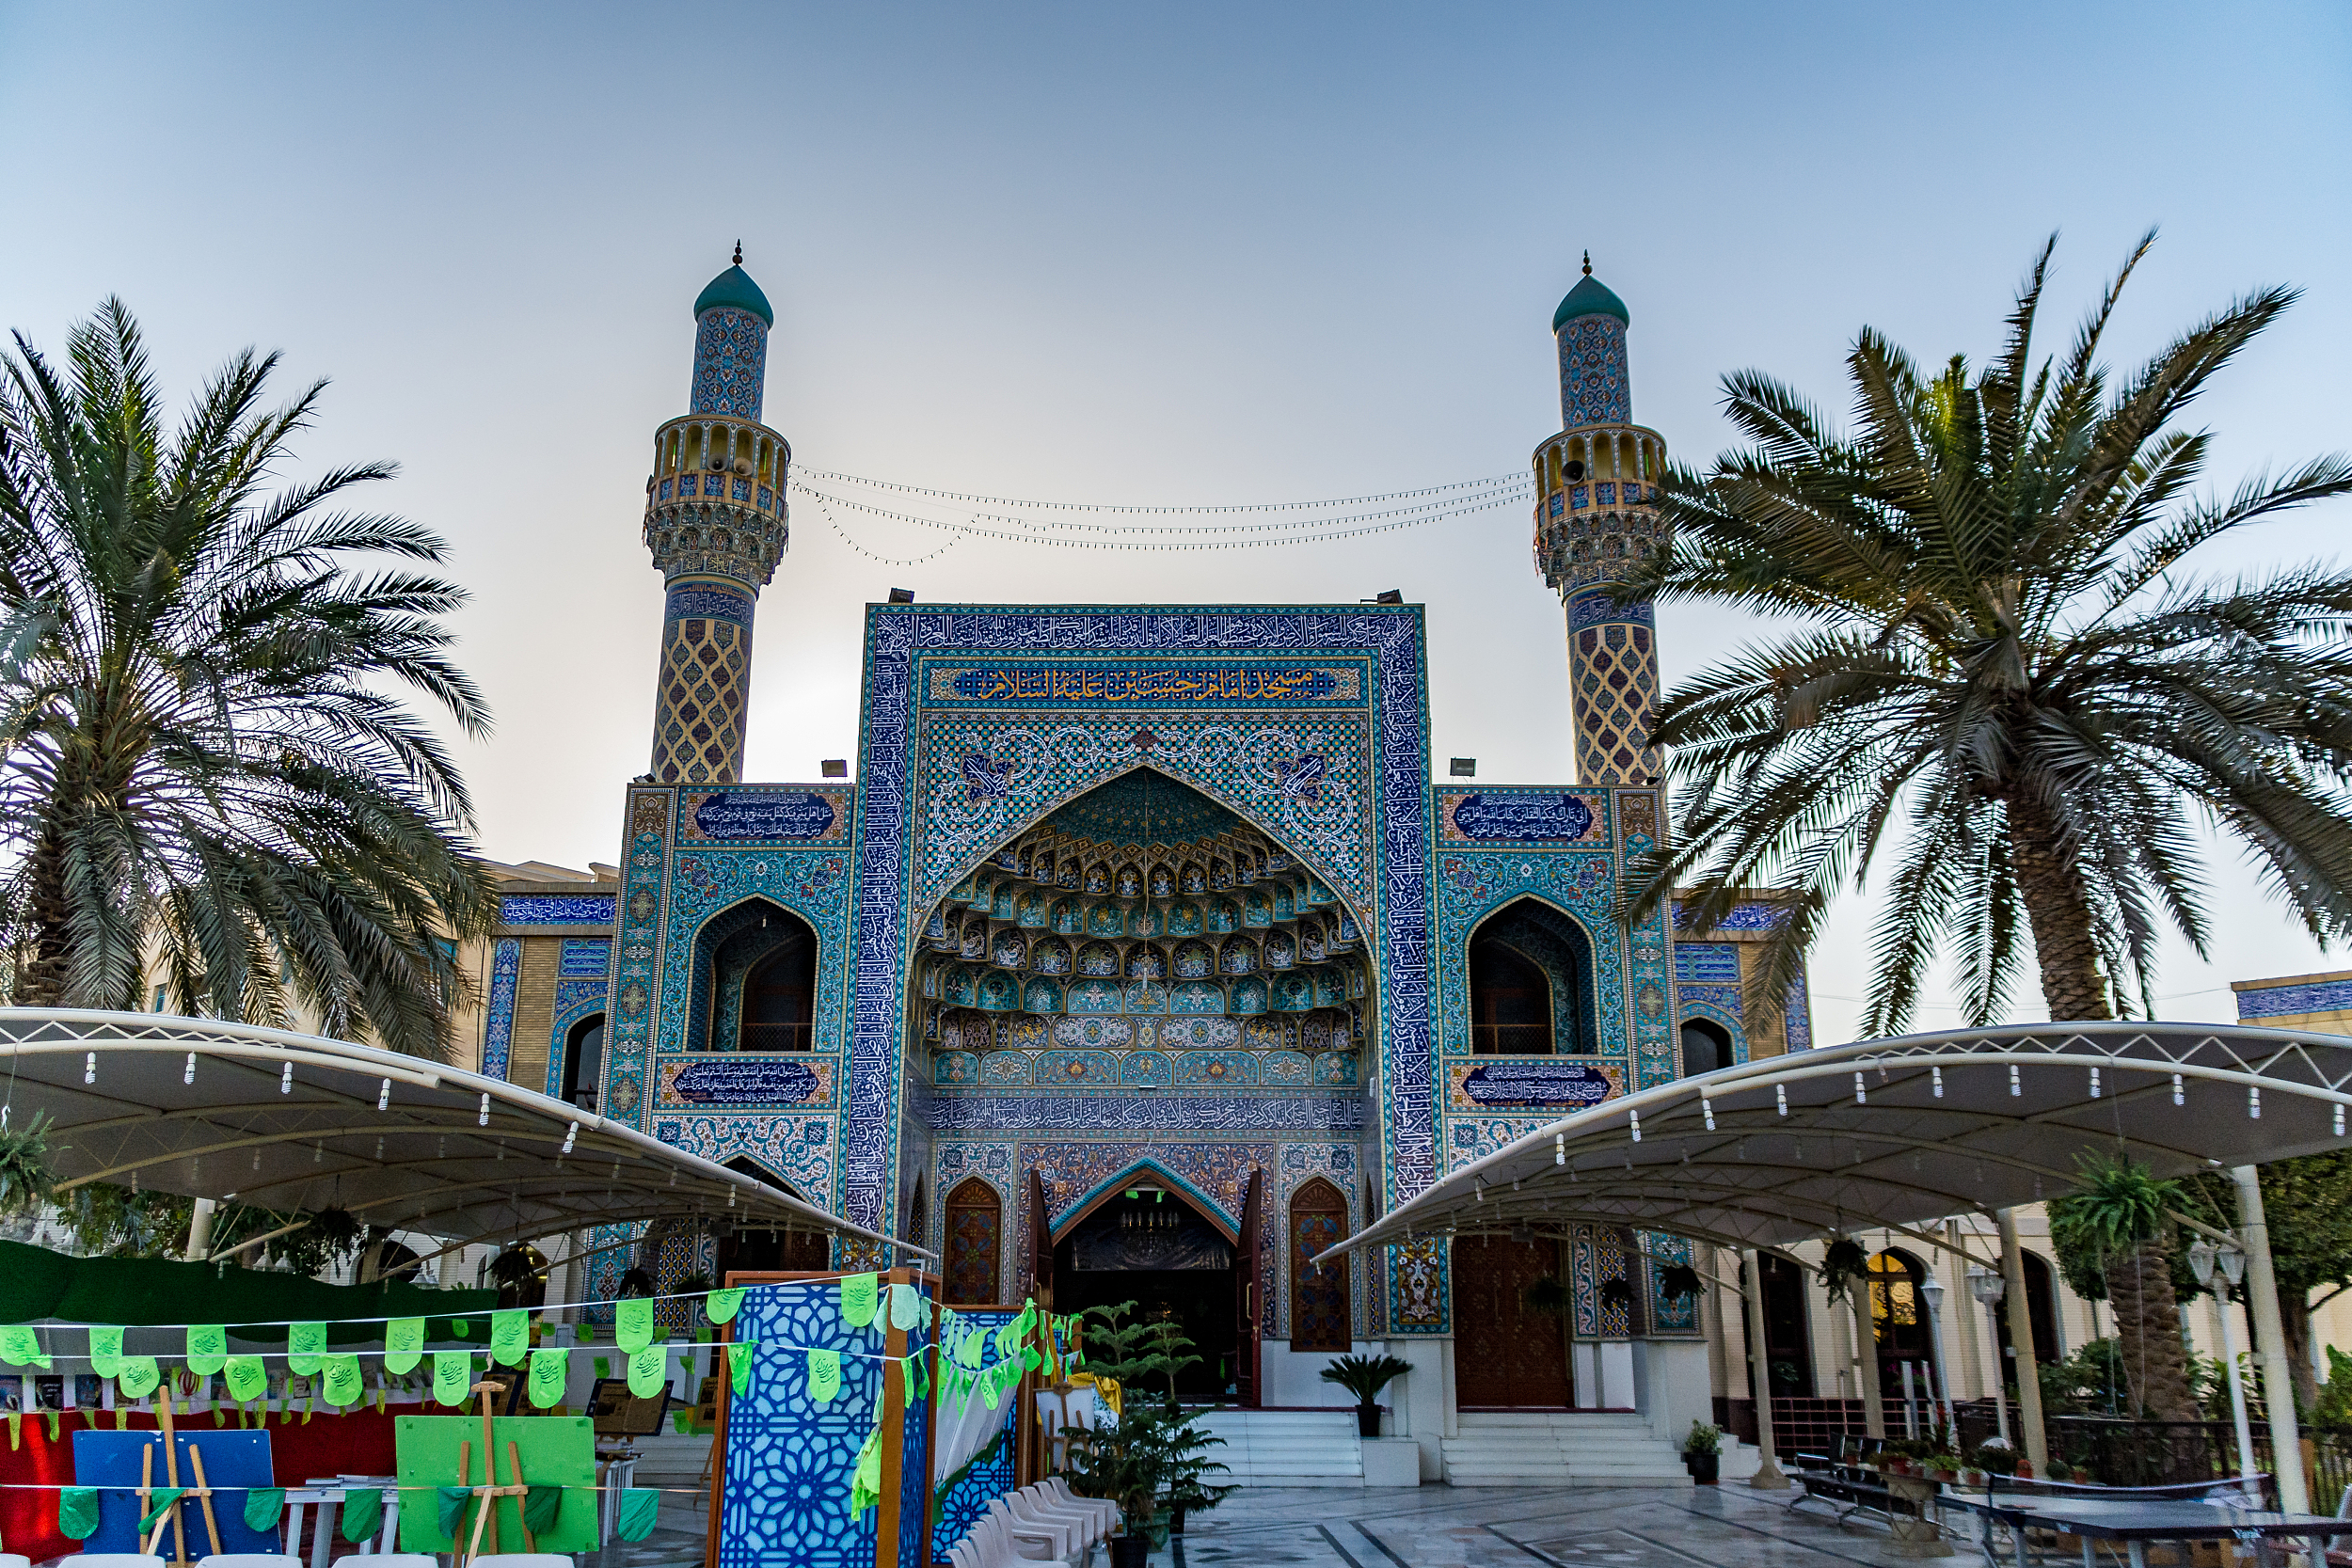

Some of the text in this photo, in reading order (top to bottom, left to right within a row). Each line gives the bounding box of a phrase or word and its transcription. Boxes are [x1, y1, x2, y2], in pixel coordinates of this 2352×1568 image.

[980, 669, 1057, 700] السلام
[1056, 669, 1104, 700] عليه
[1245, 669, 1312, 700] مسجد
